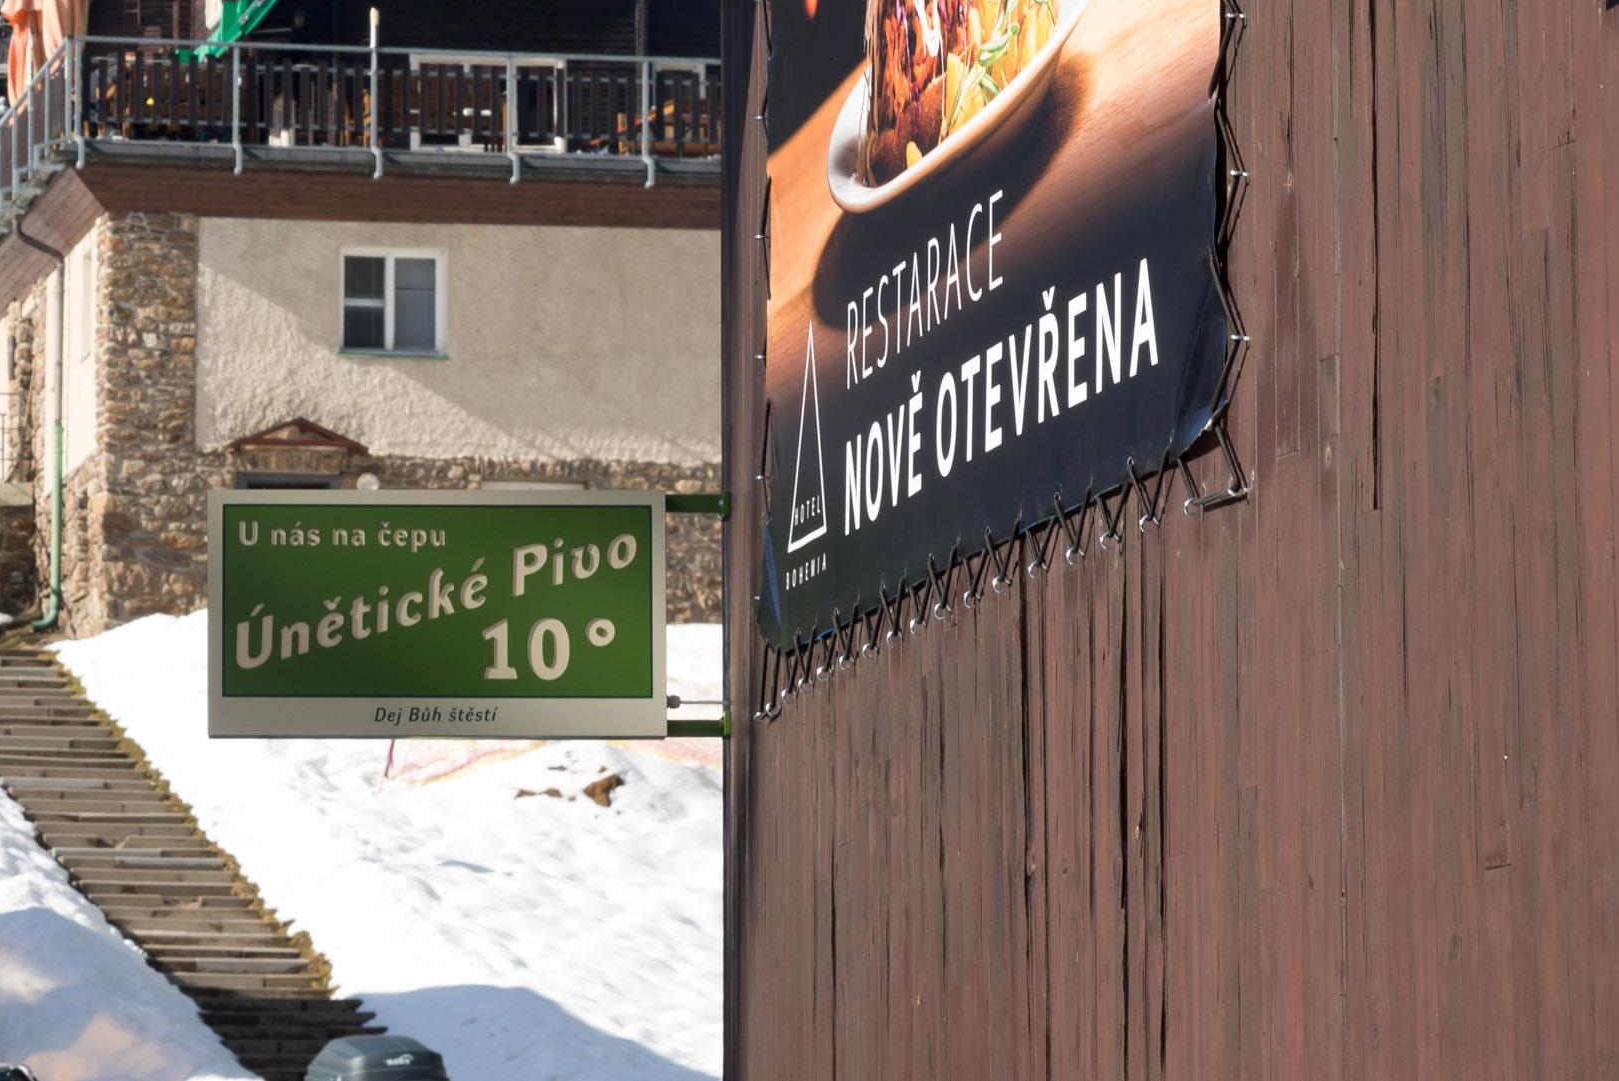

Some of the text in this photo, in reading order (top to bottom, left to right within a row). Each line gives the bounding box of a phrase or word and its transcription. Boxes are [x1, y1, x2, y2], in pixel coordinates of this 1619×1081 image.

[847, 189, 1003, 390] RESTARACE
[844, 257, 1159, 536] NOVĚ OTEVŘENA
[794, 494, 821, 527] HOTEL
[239, 520, 447, 553] U nás na čepu
[785, 552, 827, 591] BOHEMIA
[236, 533, 638, 670] Únětické Pivo
[374, 706, 499, 727] Dej Bůh štěstí
